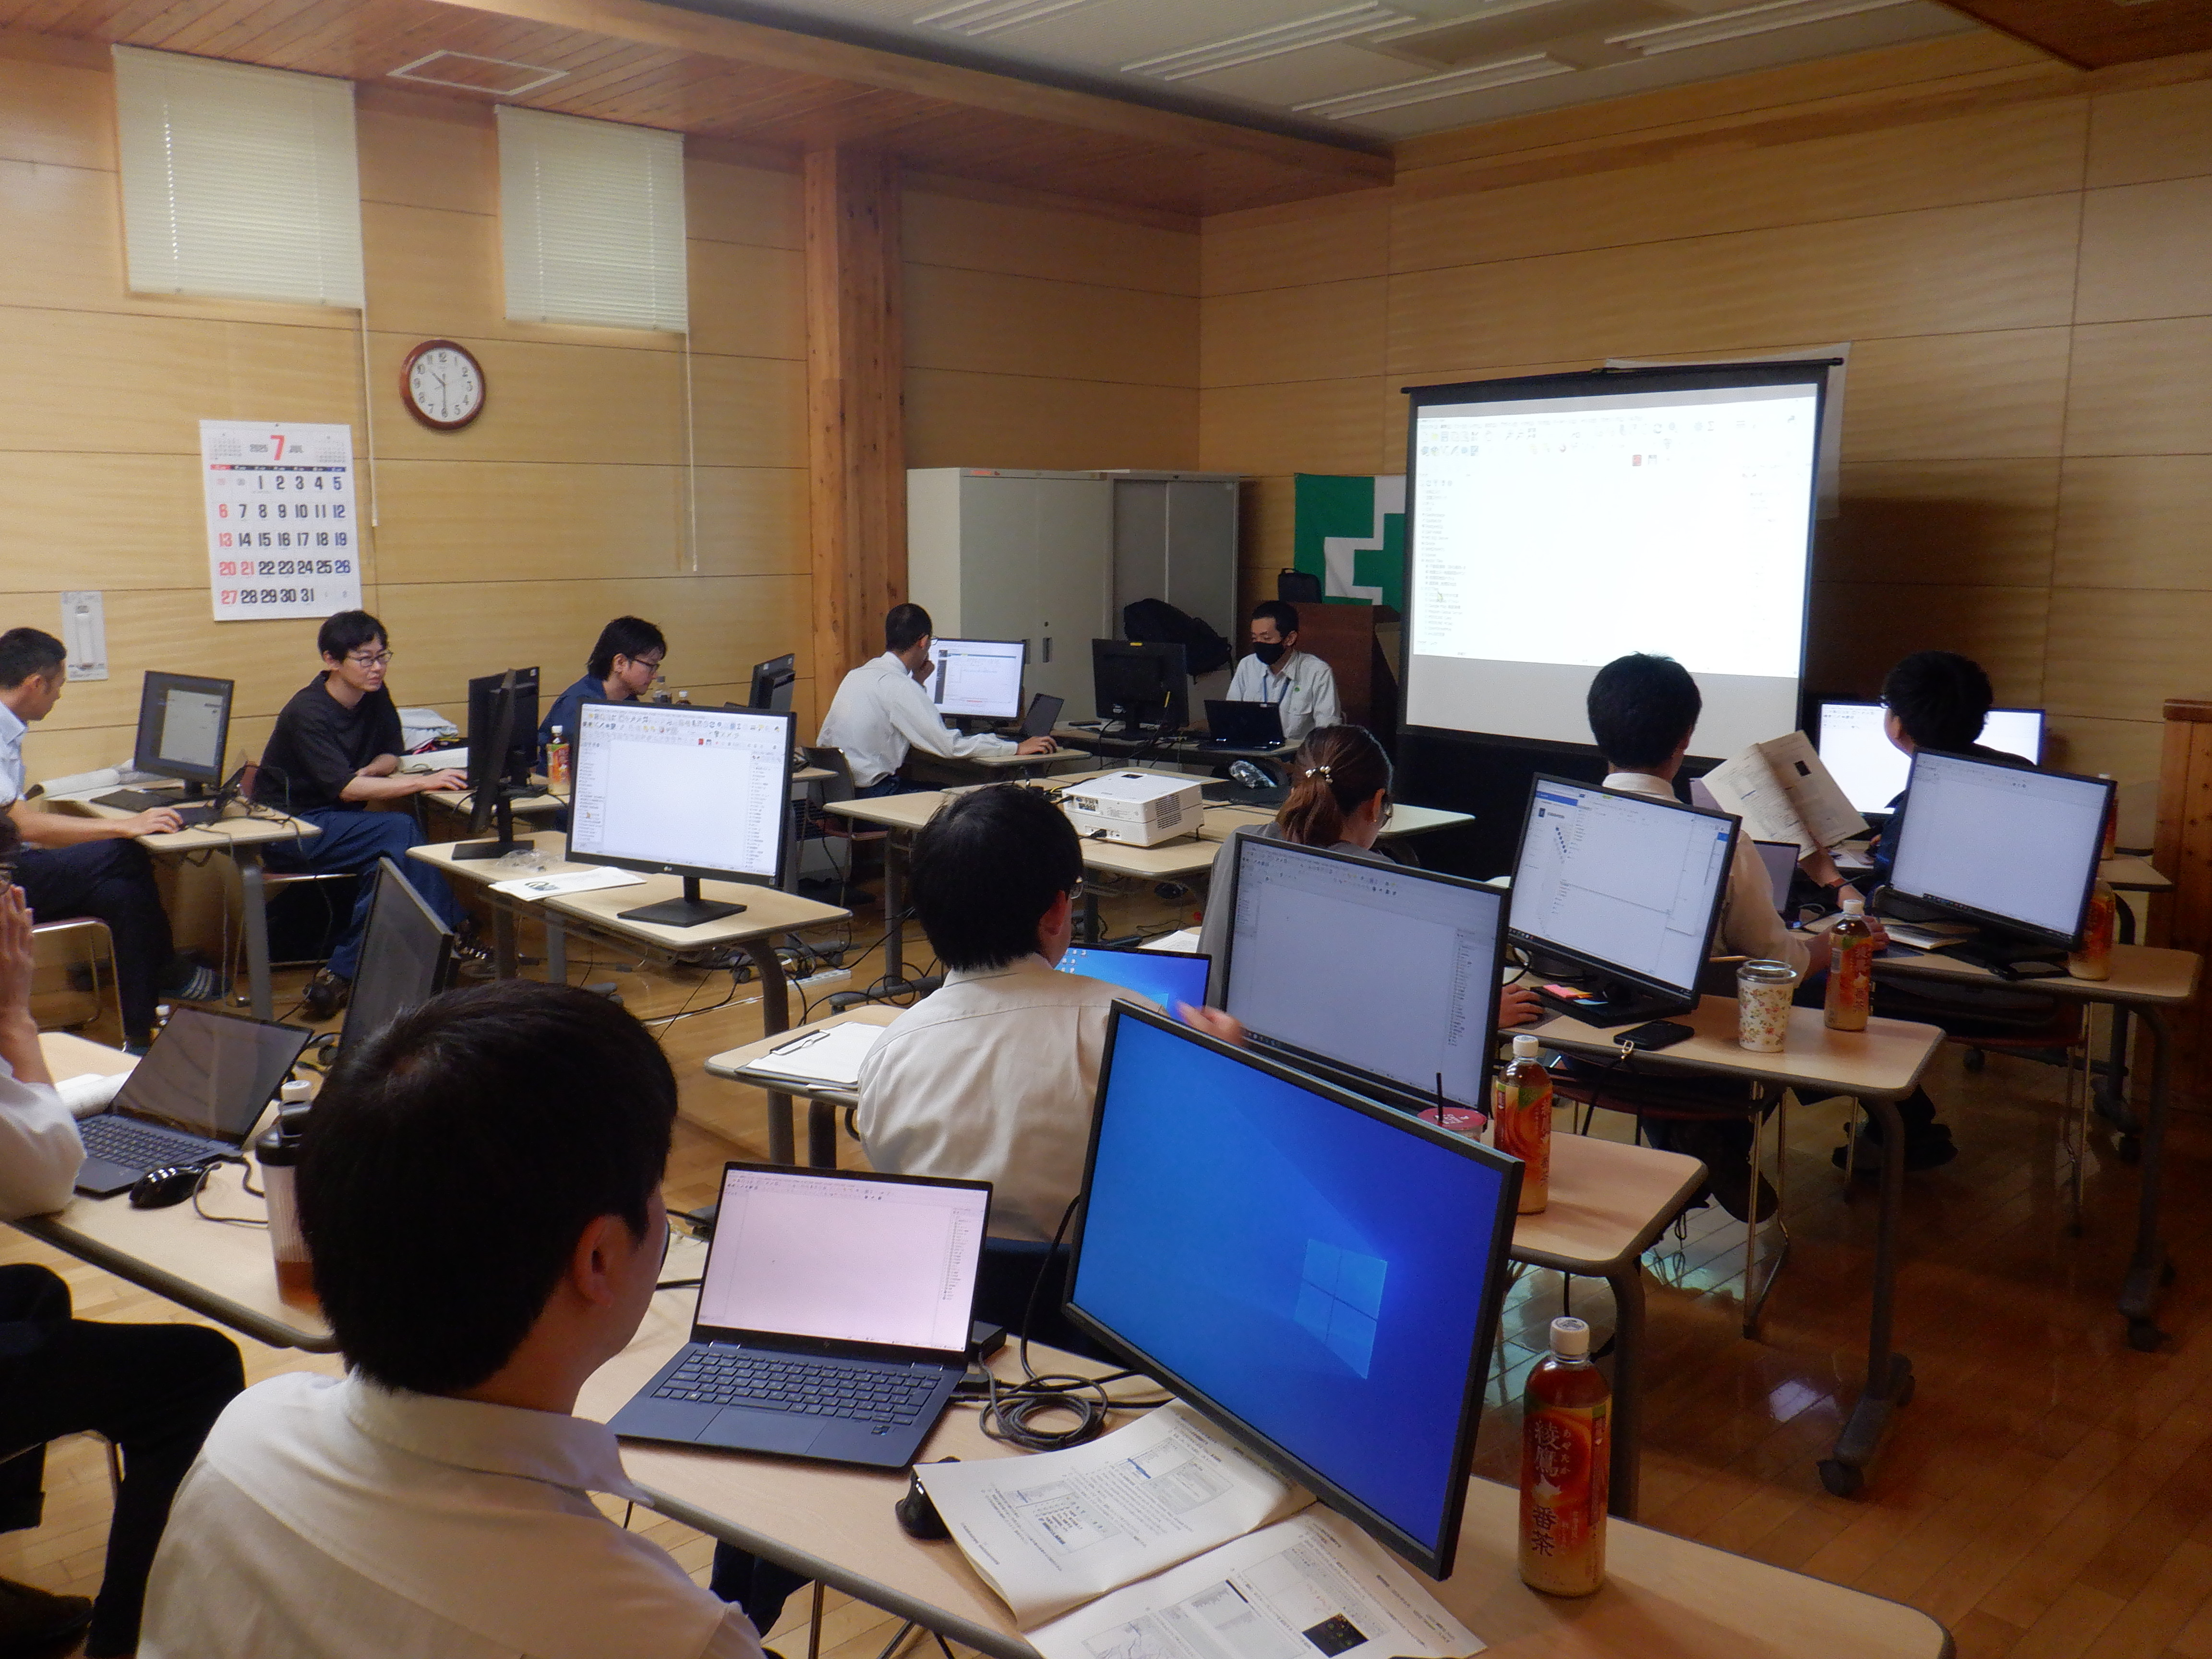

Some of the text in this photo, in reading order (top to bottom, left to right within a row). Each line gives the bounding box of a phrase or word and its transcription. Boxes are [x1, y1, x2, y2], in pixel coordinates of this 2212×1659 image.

[454, 405, 460, 414] 5
[271, 435, 285, 460] 7
[258, 475, 263, 490] 1
[276, 476, 284, 490] 2
[296, 476, 304, 490] 3
[315, 477, 323, 490] 4
[333, 477, 341, 490] 5
[219, 504, 345, 518] 6 7 8 9 10 11 12
[219, 532, 347, 547] 13 14 15 16 17 18 19
[219, 560, 350, 576] 20 21 22 23 24 25 26
[221, 590, 238, 604] 27
[241, 590, 257, 603] 28
[261, 589, 277, 603] 29
[280, 589, 296, 602] 30
[301, 589, 314, 602] 31
[1531, 1506, 1558, 1557] 番茶
